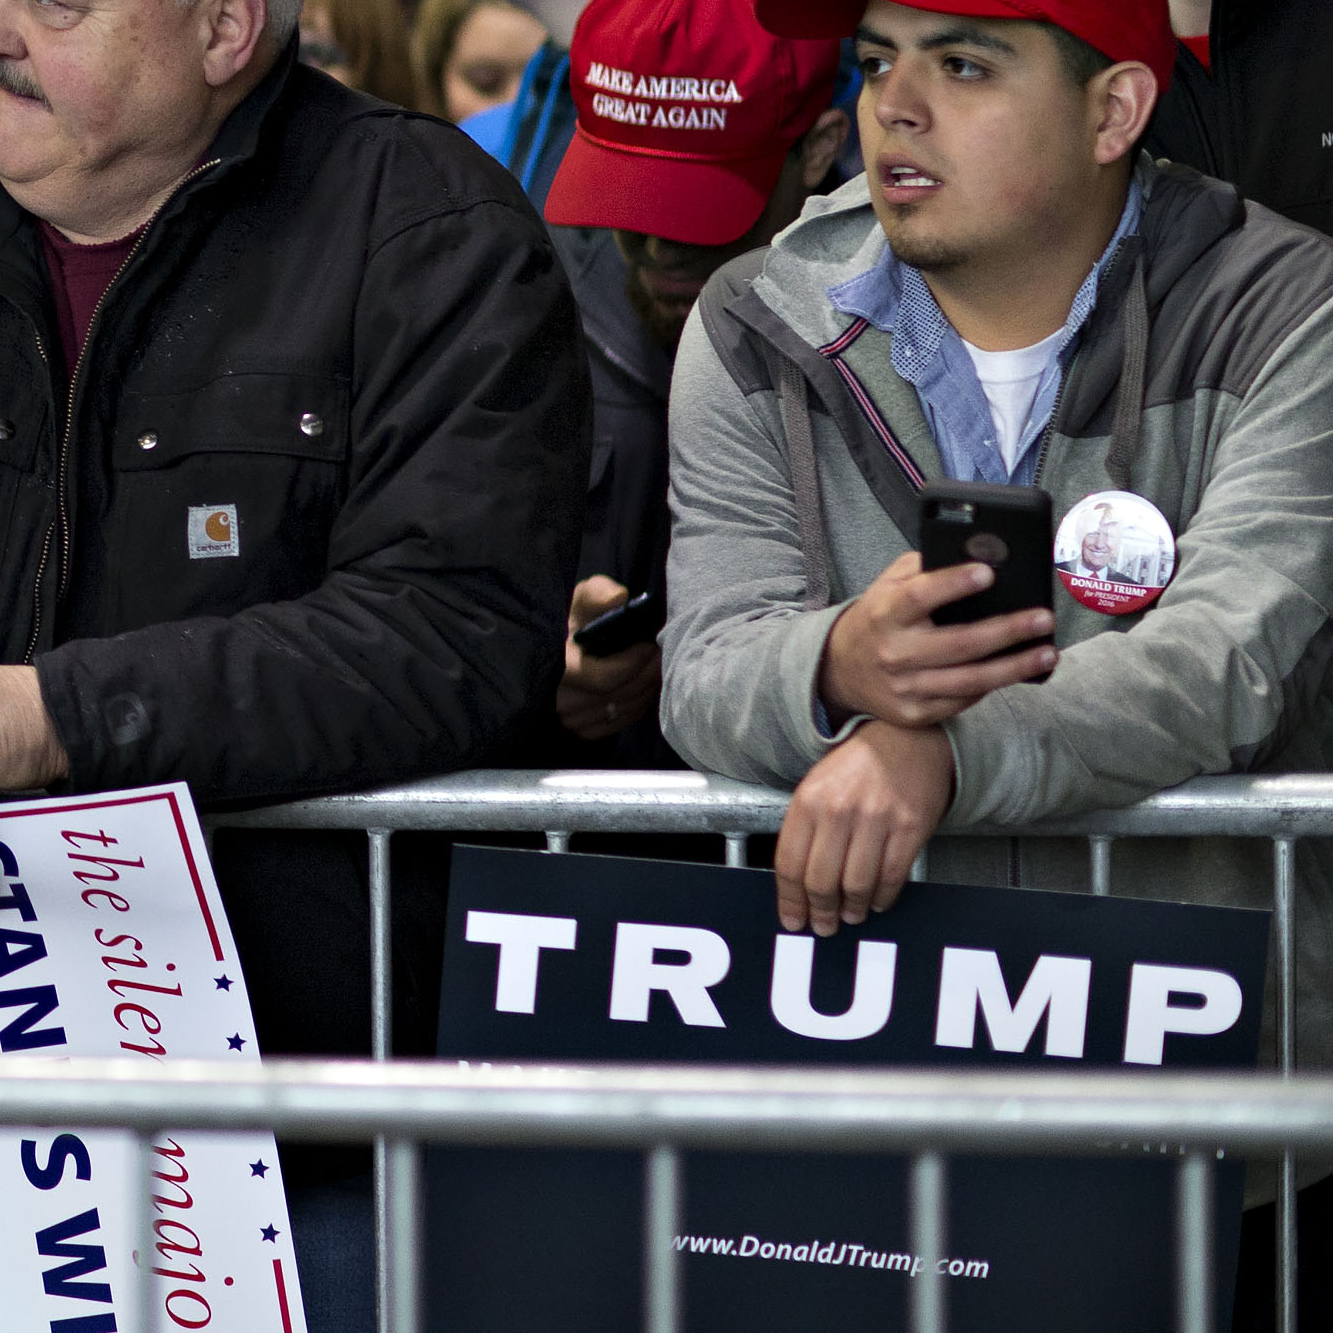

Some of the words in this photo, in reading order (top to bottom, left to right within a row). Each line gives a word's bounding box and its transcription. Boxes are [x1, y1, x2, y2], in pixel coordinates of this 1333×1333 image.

[585, 61, 634, 96] MAKE
[633, 74, 743, 103] AMERICA
[593, 92, 652, 126] GREAT
[651, 104, 728, 131] AGAIN
[1071, 577, 1112, 592] DONALD
[1113, 585, 1147, 597] TRUMP
[1084, 590, 1095, 598] for
[1094, 591, 1130, 602] PRESIDENT
[1097, 598, 1116, 607] 2016
[61, 829, 145, 912] the
[465, 910, 1244, 1065] TRUMP
